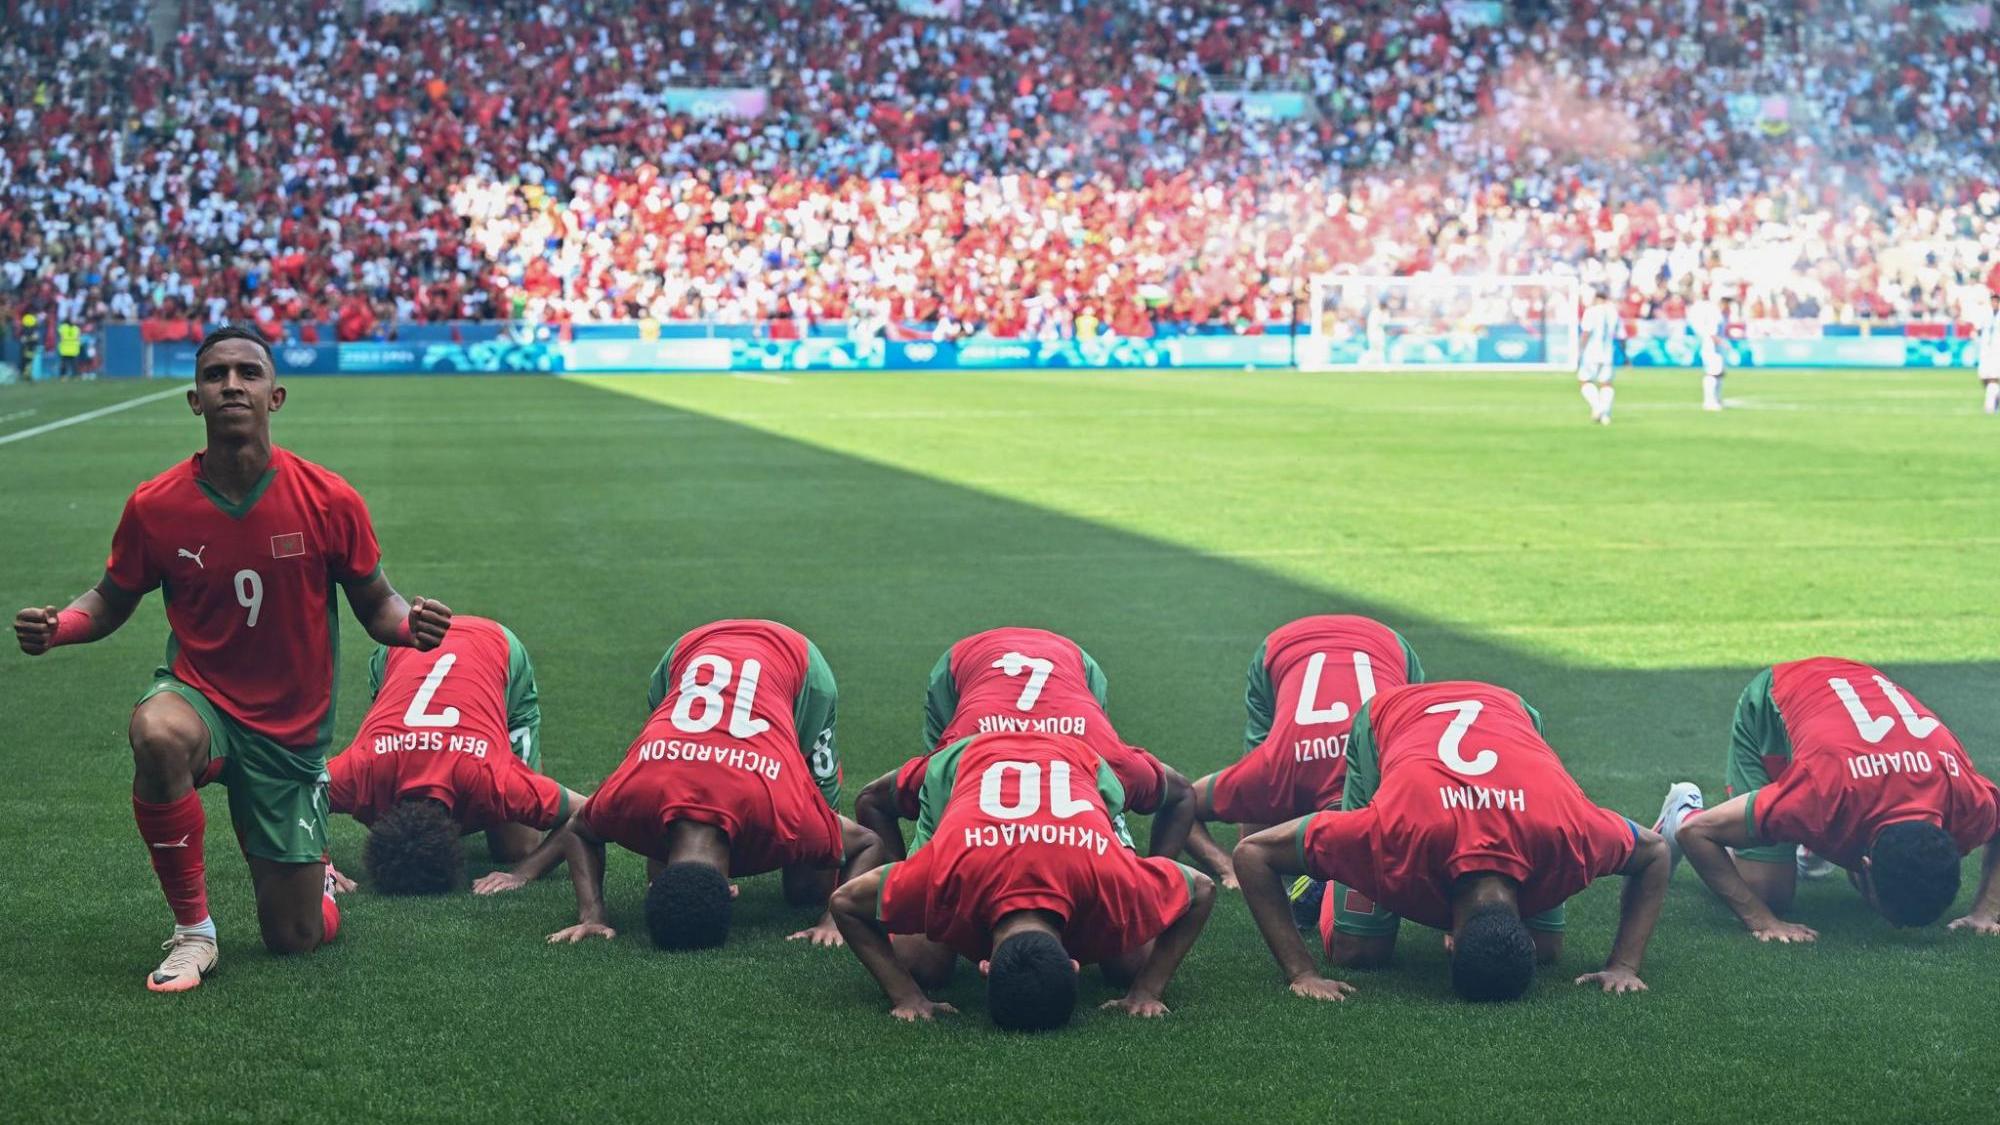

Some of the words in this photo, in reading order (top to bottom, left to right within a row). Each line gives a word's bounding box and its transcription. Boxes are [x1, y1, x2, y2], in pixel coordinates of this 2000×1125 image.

[234, 569, 263, 627] 9
[404, 653, 460, 727] 7
[671, 654, 769, 738] 18
[992, 652, 1054, 711] 4
[1295, 652, 1376, 725] 17
[978, 716, 1086, 736] BOUKAMIR
[1829, 675, 1940, 743] 11
[375, 731, 443, 754] SEGHIR
[449, 735, 488, 757] BEN
[639, 740, 780, 780] RICHARDSON
[1425, 700, 1497, 775] 2
[1848, 751, 1933, 778] OUAHDI
[1939, 751, 1959, 777] EL
[981, 761, 1095, 819] 10
[1440, 786, 1526, 811] HAKIMI
[965, 823, 1108, 855] AKHOMACH
